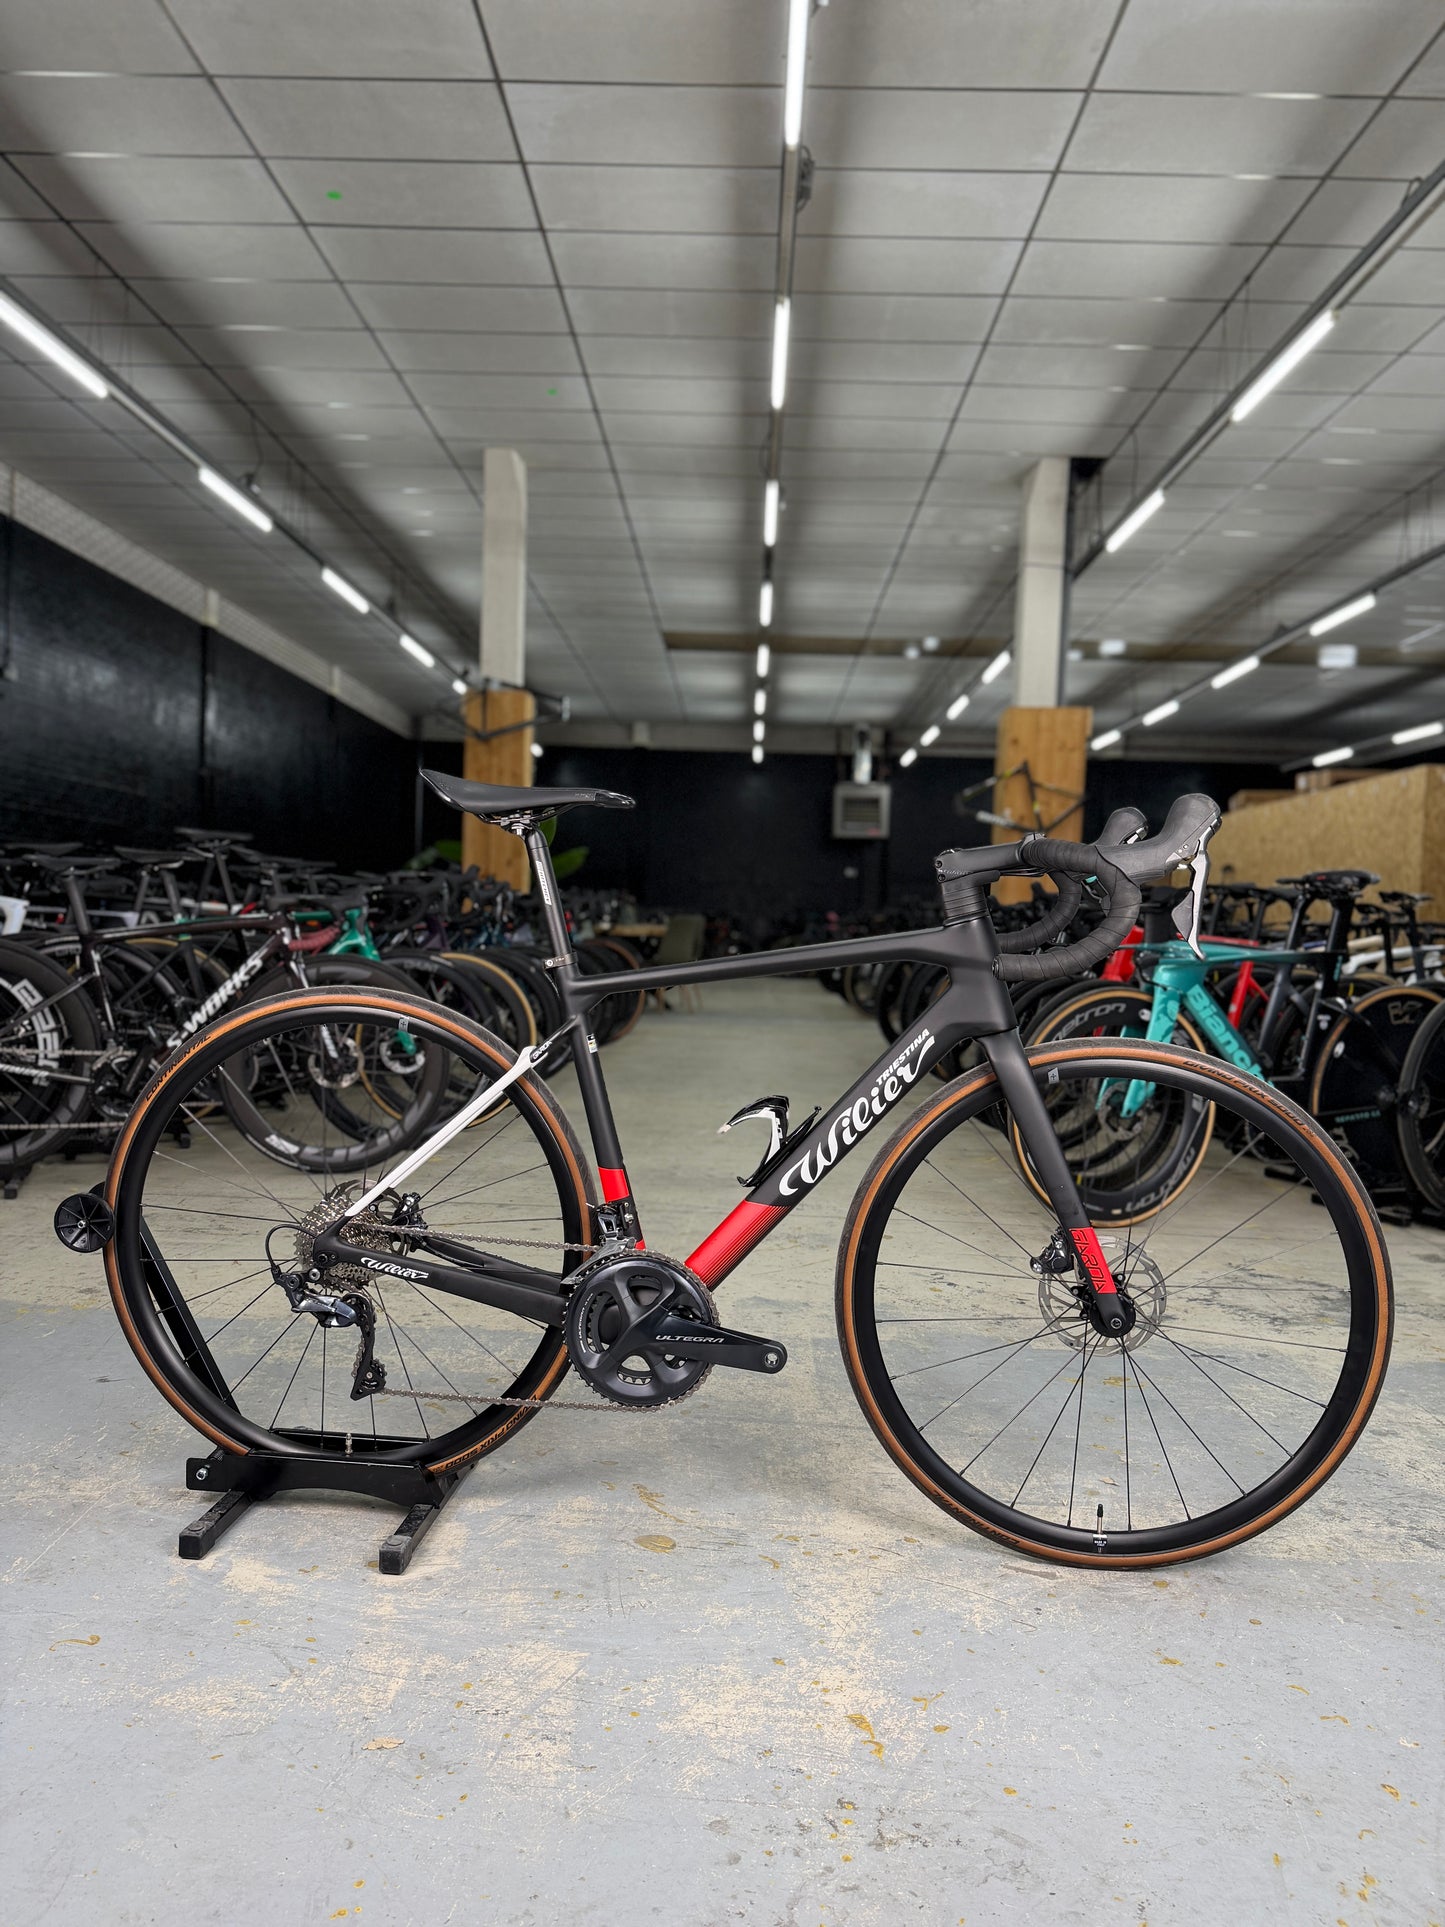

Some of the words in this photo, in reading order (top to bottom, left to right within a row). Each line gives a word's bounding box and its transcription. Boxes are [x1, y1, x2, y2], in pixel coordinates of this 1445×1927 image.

[166, 956, 263, 1048] S-WORKS
[145, 1034, 211, 1101] CONTINENTAL
[876, 1028, 930, 1085] TRIESTINA
[779, 1036, 935, 1196] Wilier
[1234, 1077, 1267, 1099] PRIX
[1268, 1095, 1304, 1126] 5000
[361, 1257, 429, 1279] Wilier
[1070, 1229, 1107, 1293] GARDA
[655, 1334, 725, 1343] ULTEGRA
[445, 1447, 479, 1470] 5000
[479, 1427, 505, 1451] PRIX
